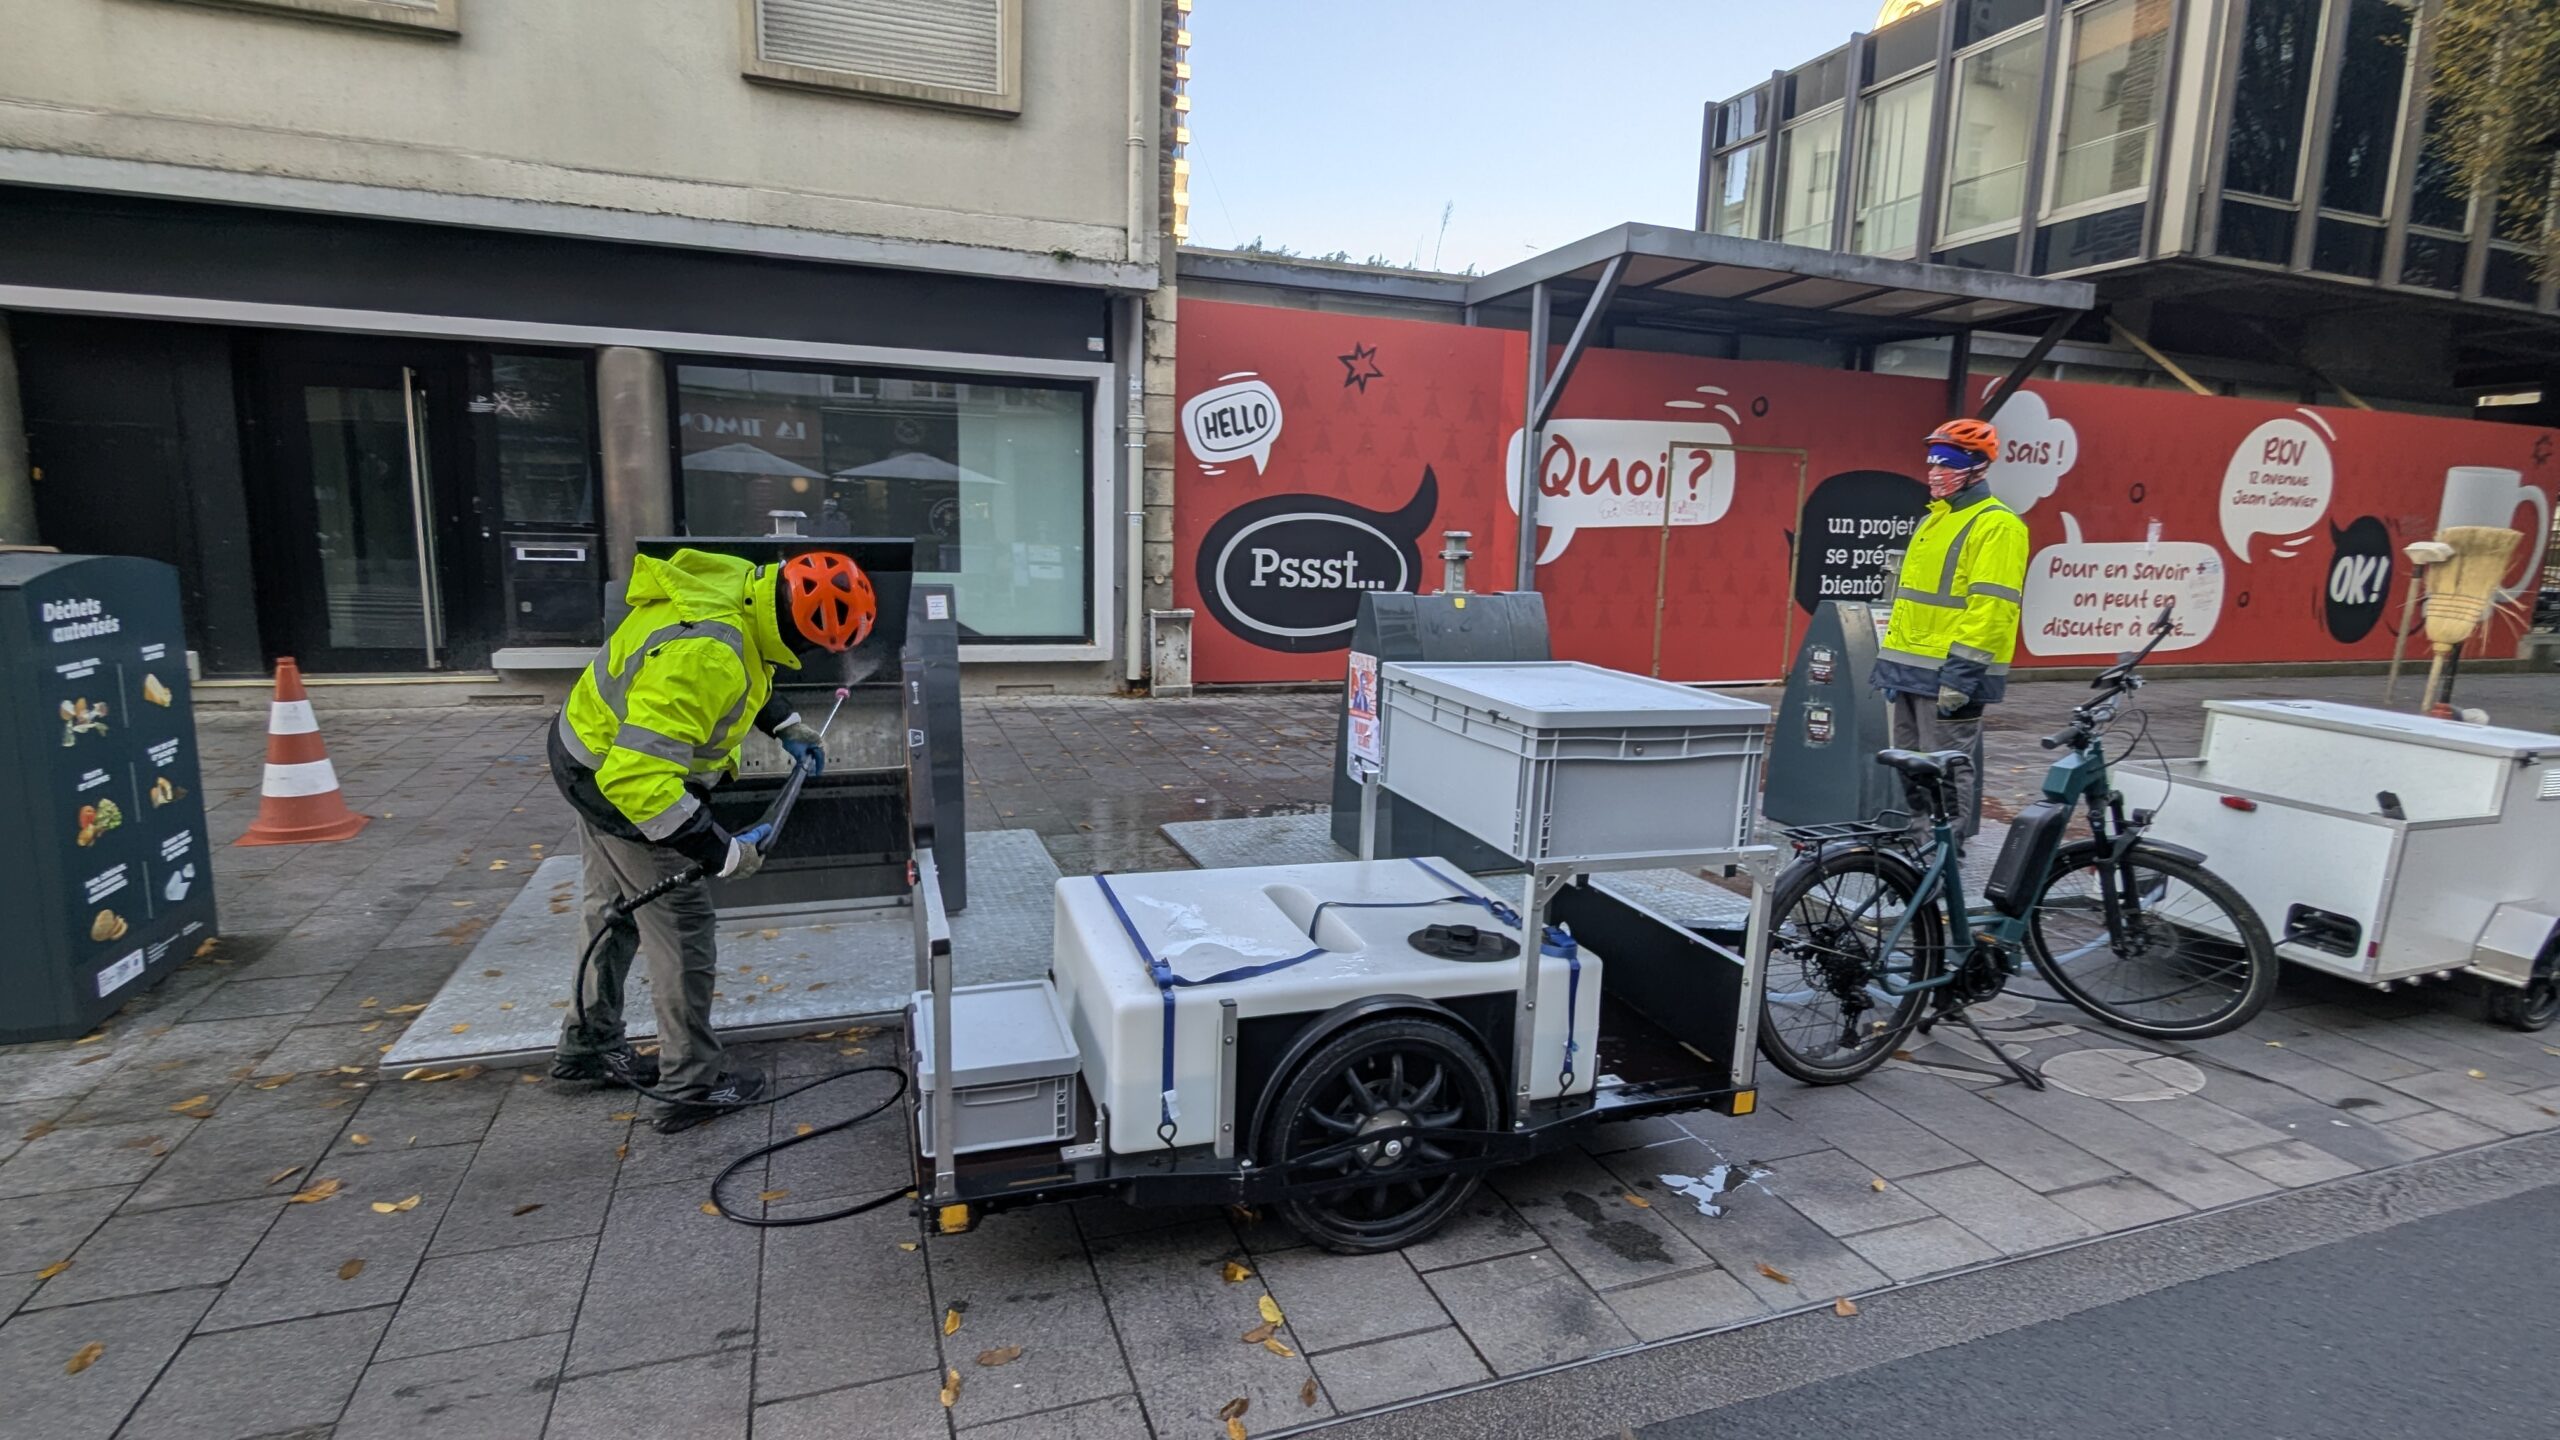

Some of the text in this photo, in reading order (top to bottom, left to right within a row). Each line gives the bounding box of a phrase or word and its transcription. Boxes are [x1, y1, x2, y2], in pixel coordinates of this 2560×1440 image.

[1203, 403, 1267, 440] HELLO
[2005, 440, 2051, 465] sais
[2262, 437, 2307, 466] RDV
[1539, 433, 1712, 501] Quoi ?
[2261, 473, 2310, 487] avenue
[1827, 515, 1916, 540] un projet
[1250, 548, 1385, 589] Pssst...
[1825, 548, 1848, 565] se
[2049, 556, 2098, 579] Pour
[2104, 564, 2127, 579] en
[1819, 574, 1886, 595] bientô
[2330, 554, 2390, 605] OK!
[43, 598, 101, 622] Déchets
[2073, 592, 2097, 607] on
[2102, 589, 2148, 611] peut
[2153, 594, 2176, 609] en
[52, 614, 120, 643] autorisés
[2043, 617, 2124, 638] discuter
[2129, 615, 2142, 636] à
